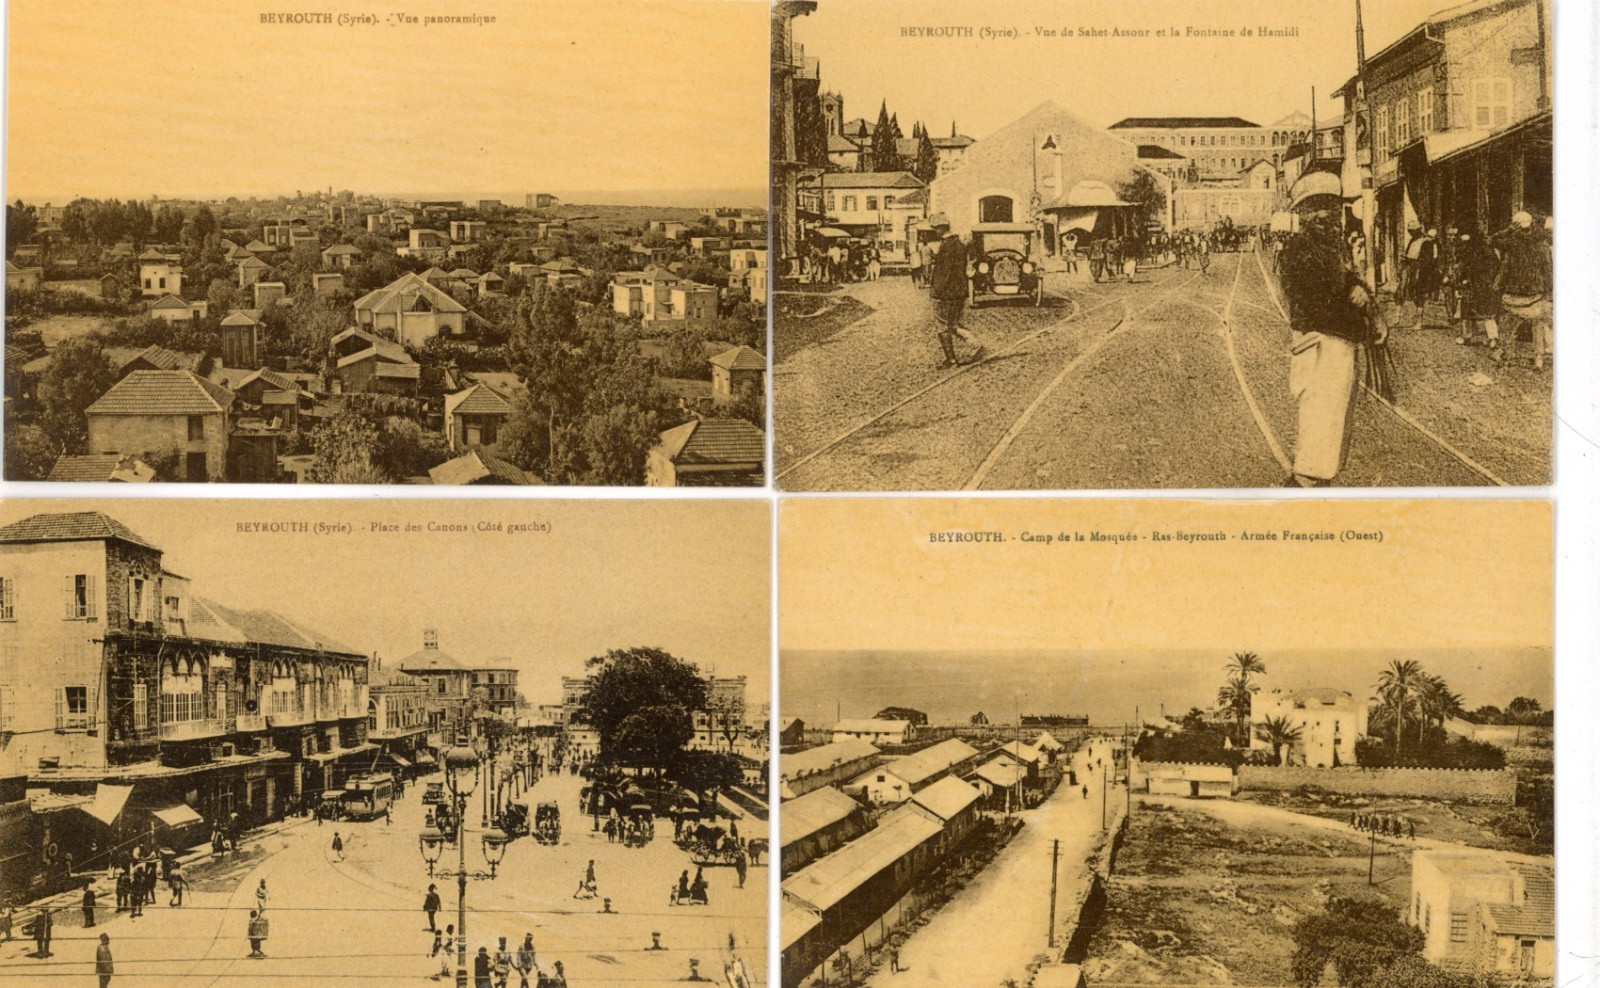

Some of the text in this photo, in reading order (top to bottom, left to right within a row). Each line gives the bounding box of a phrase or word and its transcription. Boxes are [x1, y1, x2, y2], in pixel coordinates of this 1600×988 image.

[259, 12, 333, 24] BEYROUTH
[396, 12, 419, 24] Vue
[424, 13, 497, 27] panoramique
[900, 26, 973, 37] BEYROUTH
[1034, 26, 1057, 37] Vue
[1060, 26, 1074, 37] de
[1155, 28, 1166, 37] et
[1170, 26, 1180, 37] la
[1186, 26, 1235, 37] Fontaine
[1239, 26, 1253, 37] de
[1258, 26, 1300, 37] Hamidi
[236, 521, 308, 533] BEYROUTH
[370, 521, 400, 532] Place
[404, 522, 422, 532] des
[427, 521, 468, 532] Canons
[507, 521, 552, 535] gauche)
[929, 531, 1007, 543] BEYROUTH.
[1020, 531, 1053, 546] Camp
[1057, 531, 1071, 542] de
[1074, 531, 1085, 542] la
[1089, 531, 1138, 545] Mosquée
[1240, 530, 1278, 541] Armée
[1282, 529, 1336, 543] Française
[1339, 529, 1384, 543] (Ouest)
